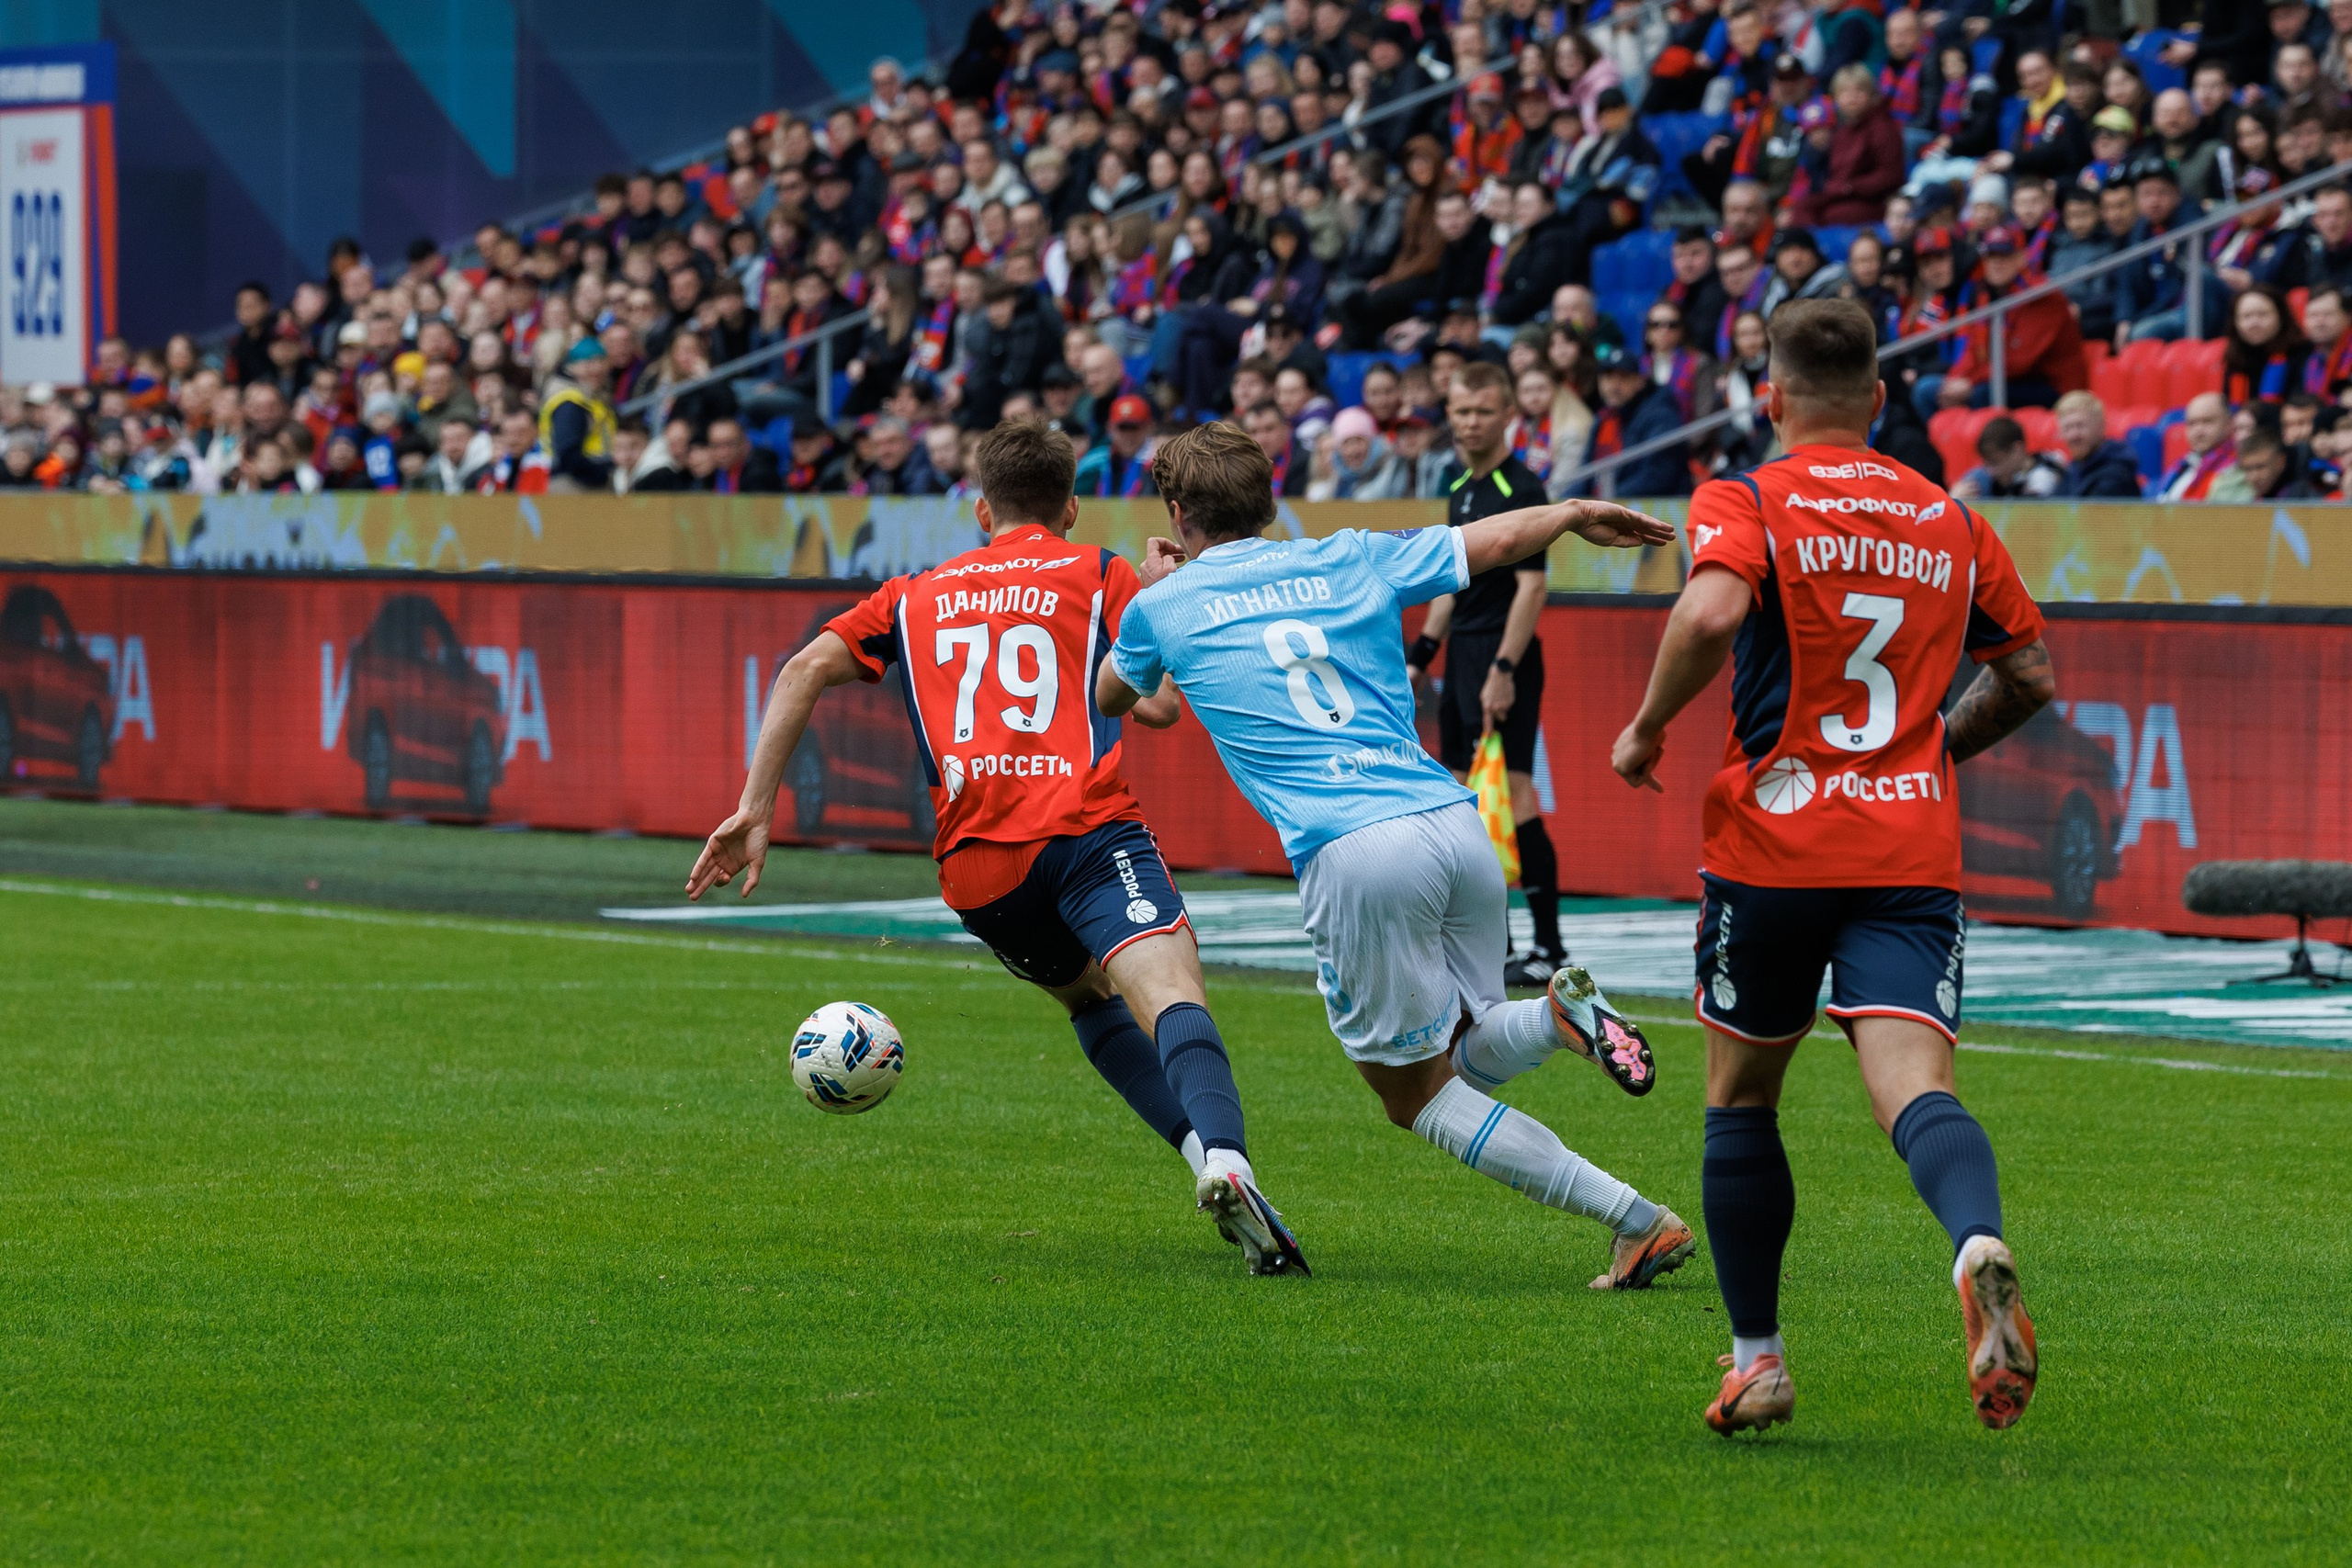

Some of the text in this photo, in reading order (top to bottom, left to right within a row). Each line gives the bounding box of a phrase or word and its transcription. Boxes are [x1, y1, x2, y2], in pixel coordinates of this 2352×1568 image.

[1795, 536, 1952, 593] КРУГОВОЙ
[935, 585, 1058, 622] ДАНИЛОВ
[1204, 577, 1331, 625] ИГНАТОВ
[935, 622, 1058, 743] 79
[1262, 618, 1355, 729] 8
[1820, 592, 1905, 751] 3
[971, 754, 1072, 780] РОССЕТИ
[1321, 962, 1352, 1013] 8
